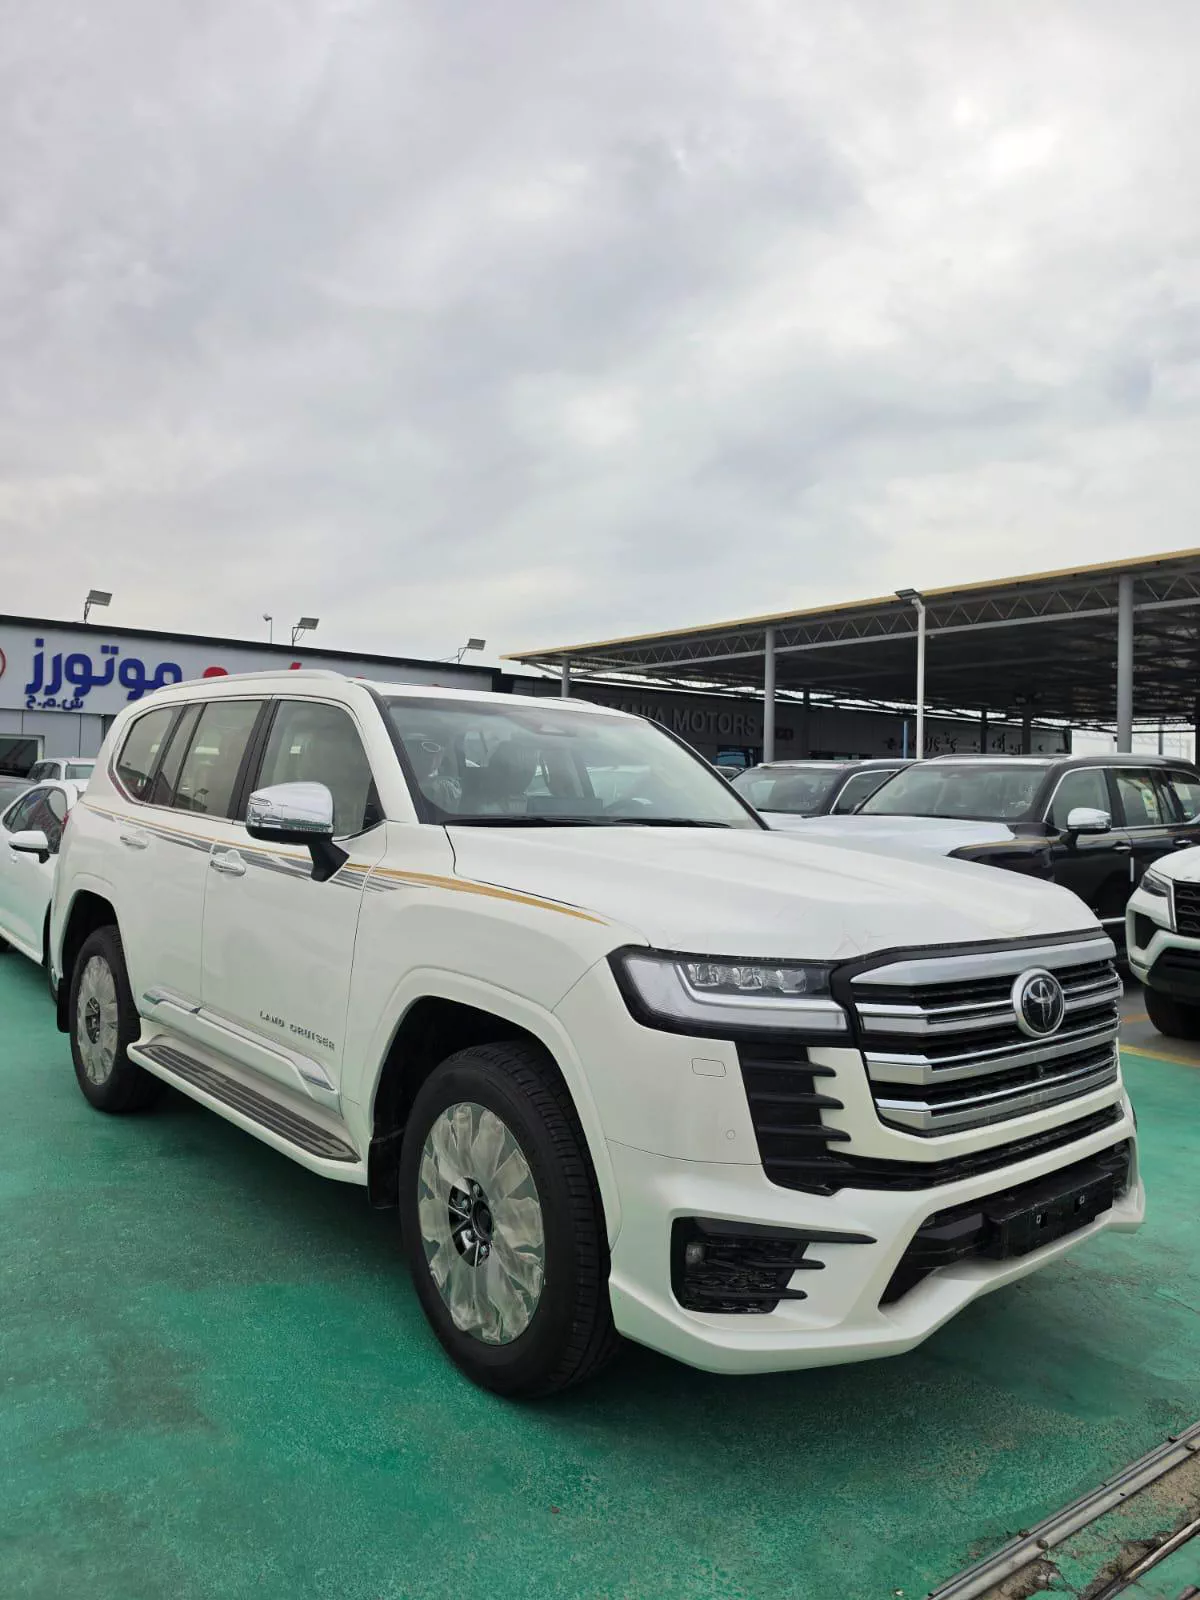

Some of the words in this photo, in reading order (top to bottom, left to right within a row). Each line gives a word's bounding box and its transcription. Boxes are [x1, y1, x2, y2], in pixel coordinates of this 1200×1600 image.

[25, 638, 182, 700] موتورز
[673, 706, 757, 736] MOTORS
[259, 1010, 285, 1028] LAND
[289, 1023, 335, 1051] CRUISER
